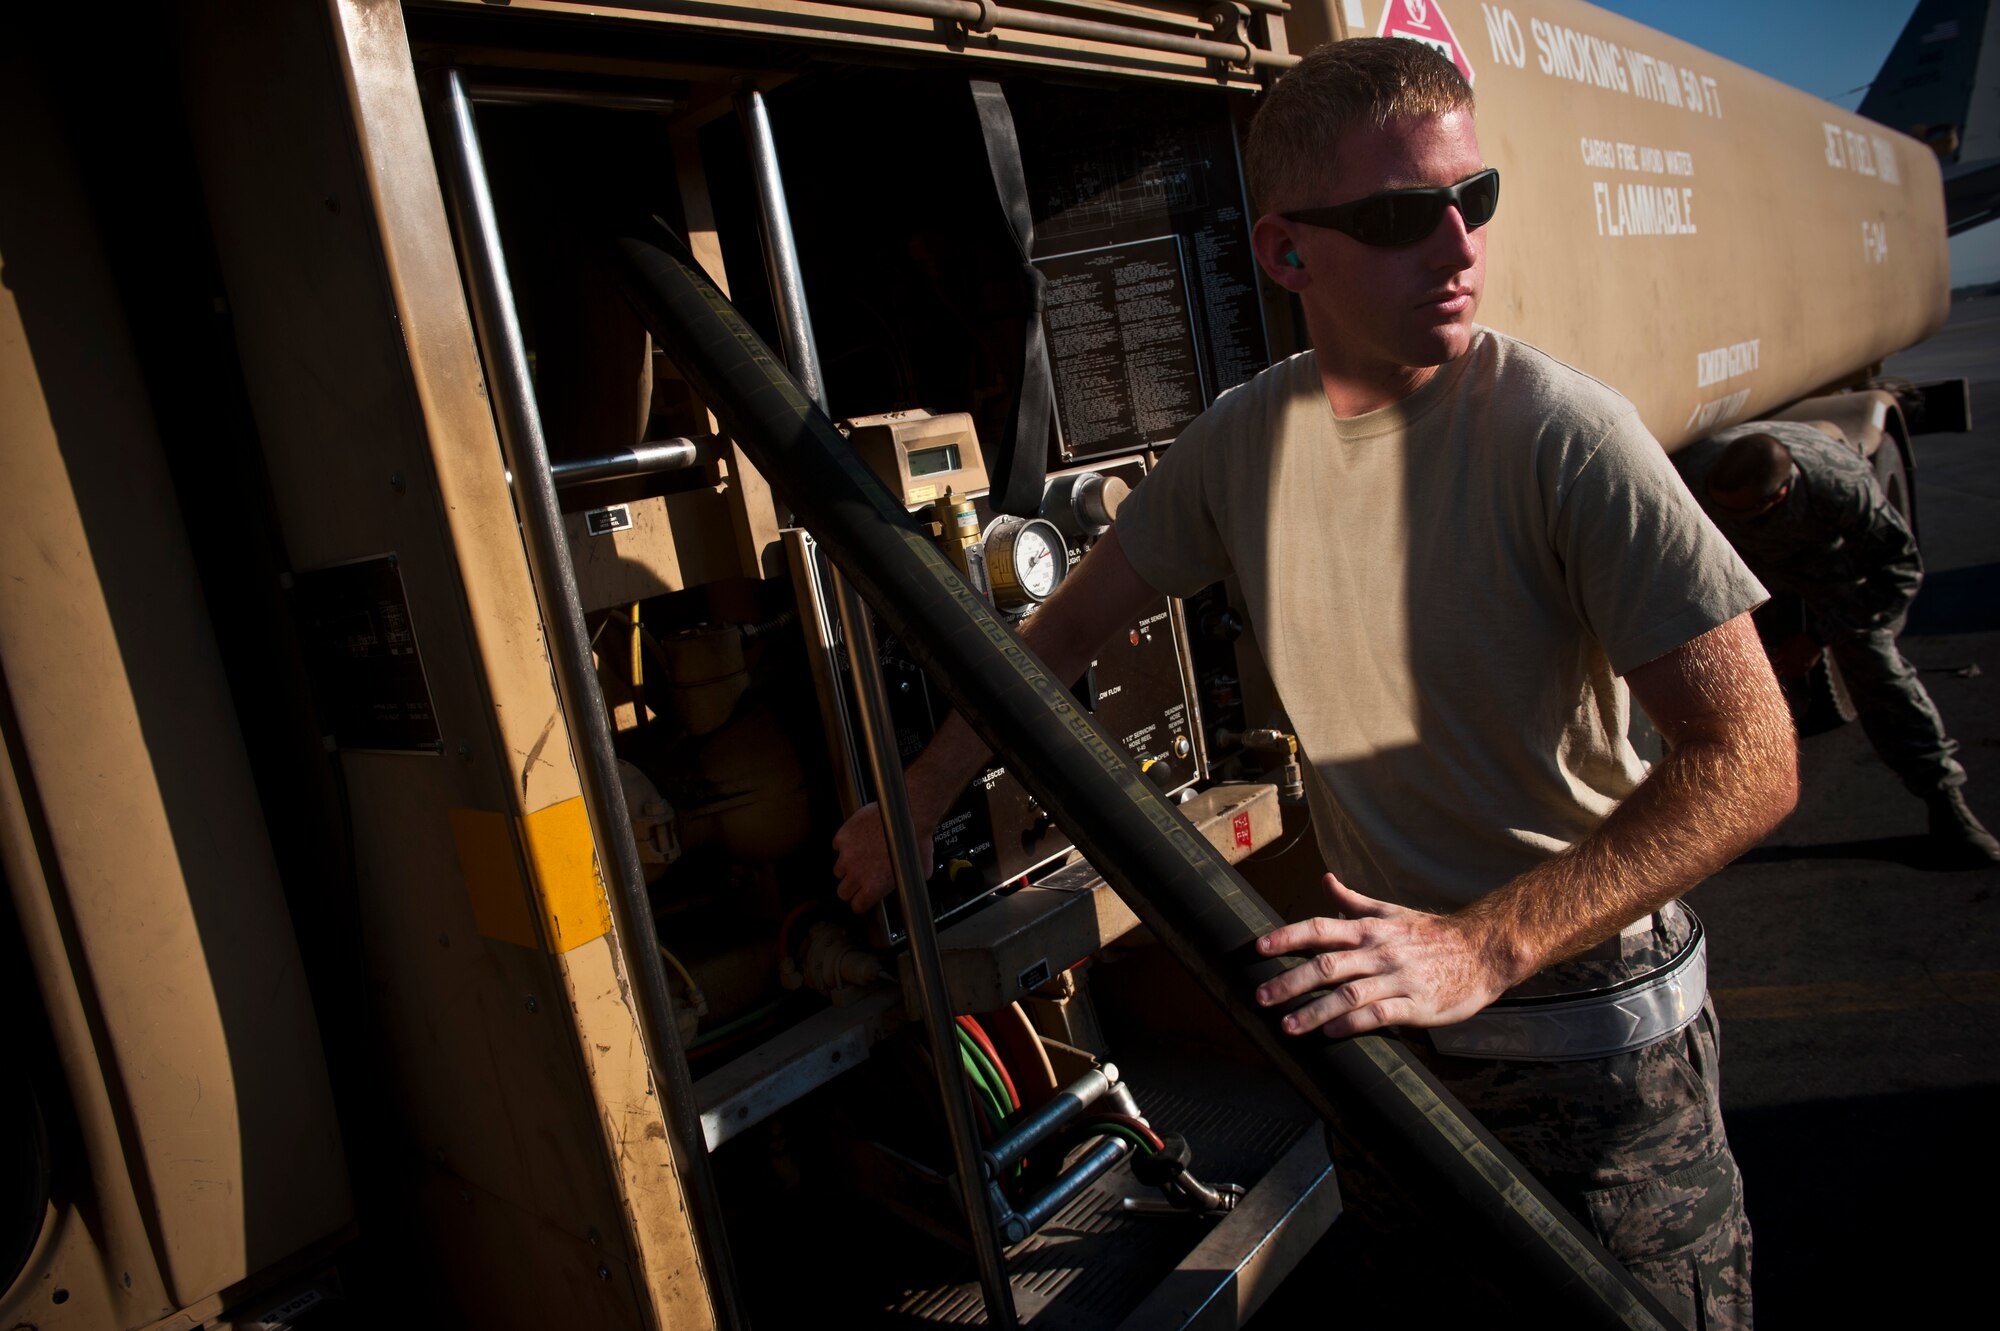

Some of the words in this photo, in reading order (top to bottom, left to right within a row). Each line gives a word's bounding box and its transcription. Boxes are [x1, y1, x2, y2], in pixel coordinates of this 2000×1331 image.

[1482, 3, 1525, 69] NO
[1531, 17, 1628, 93] SMOKING
[1623, 47, 1683, 108] WITHIN
[1680, 67, 1703, 113] 50
[1700, 75, 1722, 119] FT
[1580, 137, 1616, 169] CARGO
[1616, 142, 1639, 171] FIRE
[1593, 182, 1697, 236] FLAMMABLE
[943, 573, 1007, 642] FUEING
[1005, 645, 1071, 715] GOUND
[1108, 685, 1122, 697] FLOW
[1128, 738, 1141, 749] HOSE
[973, 767, 1005, 787] COALESCER
[941, 810, 973, 830] SERVICING
[934, 830, 951, 843] HOSE
[974, 840, 991, 854] OPEN
[282, 1291, 316, 1314] VOLT
